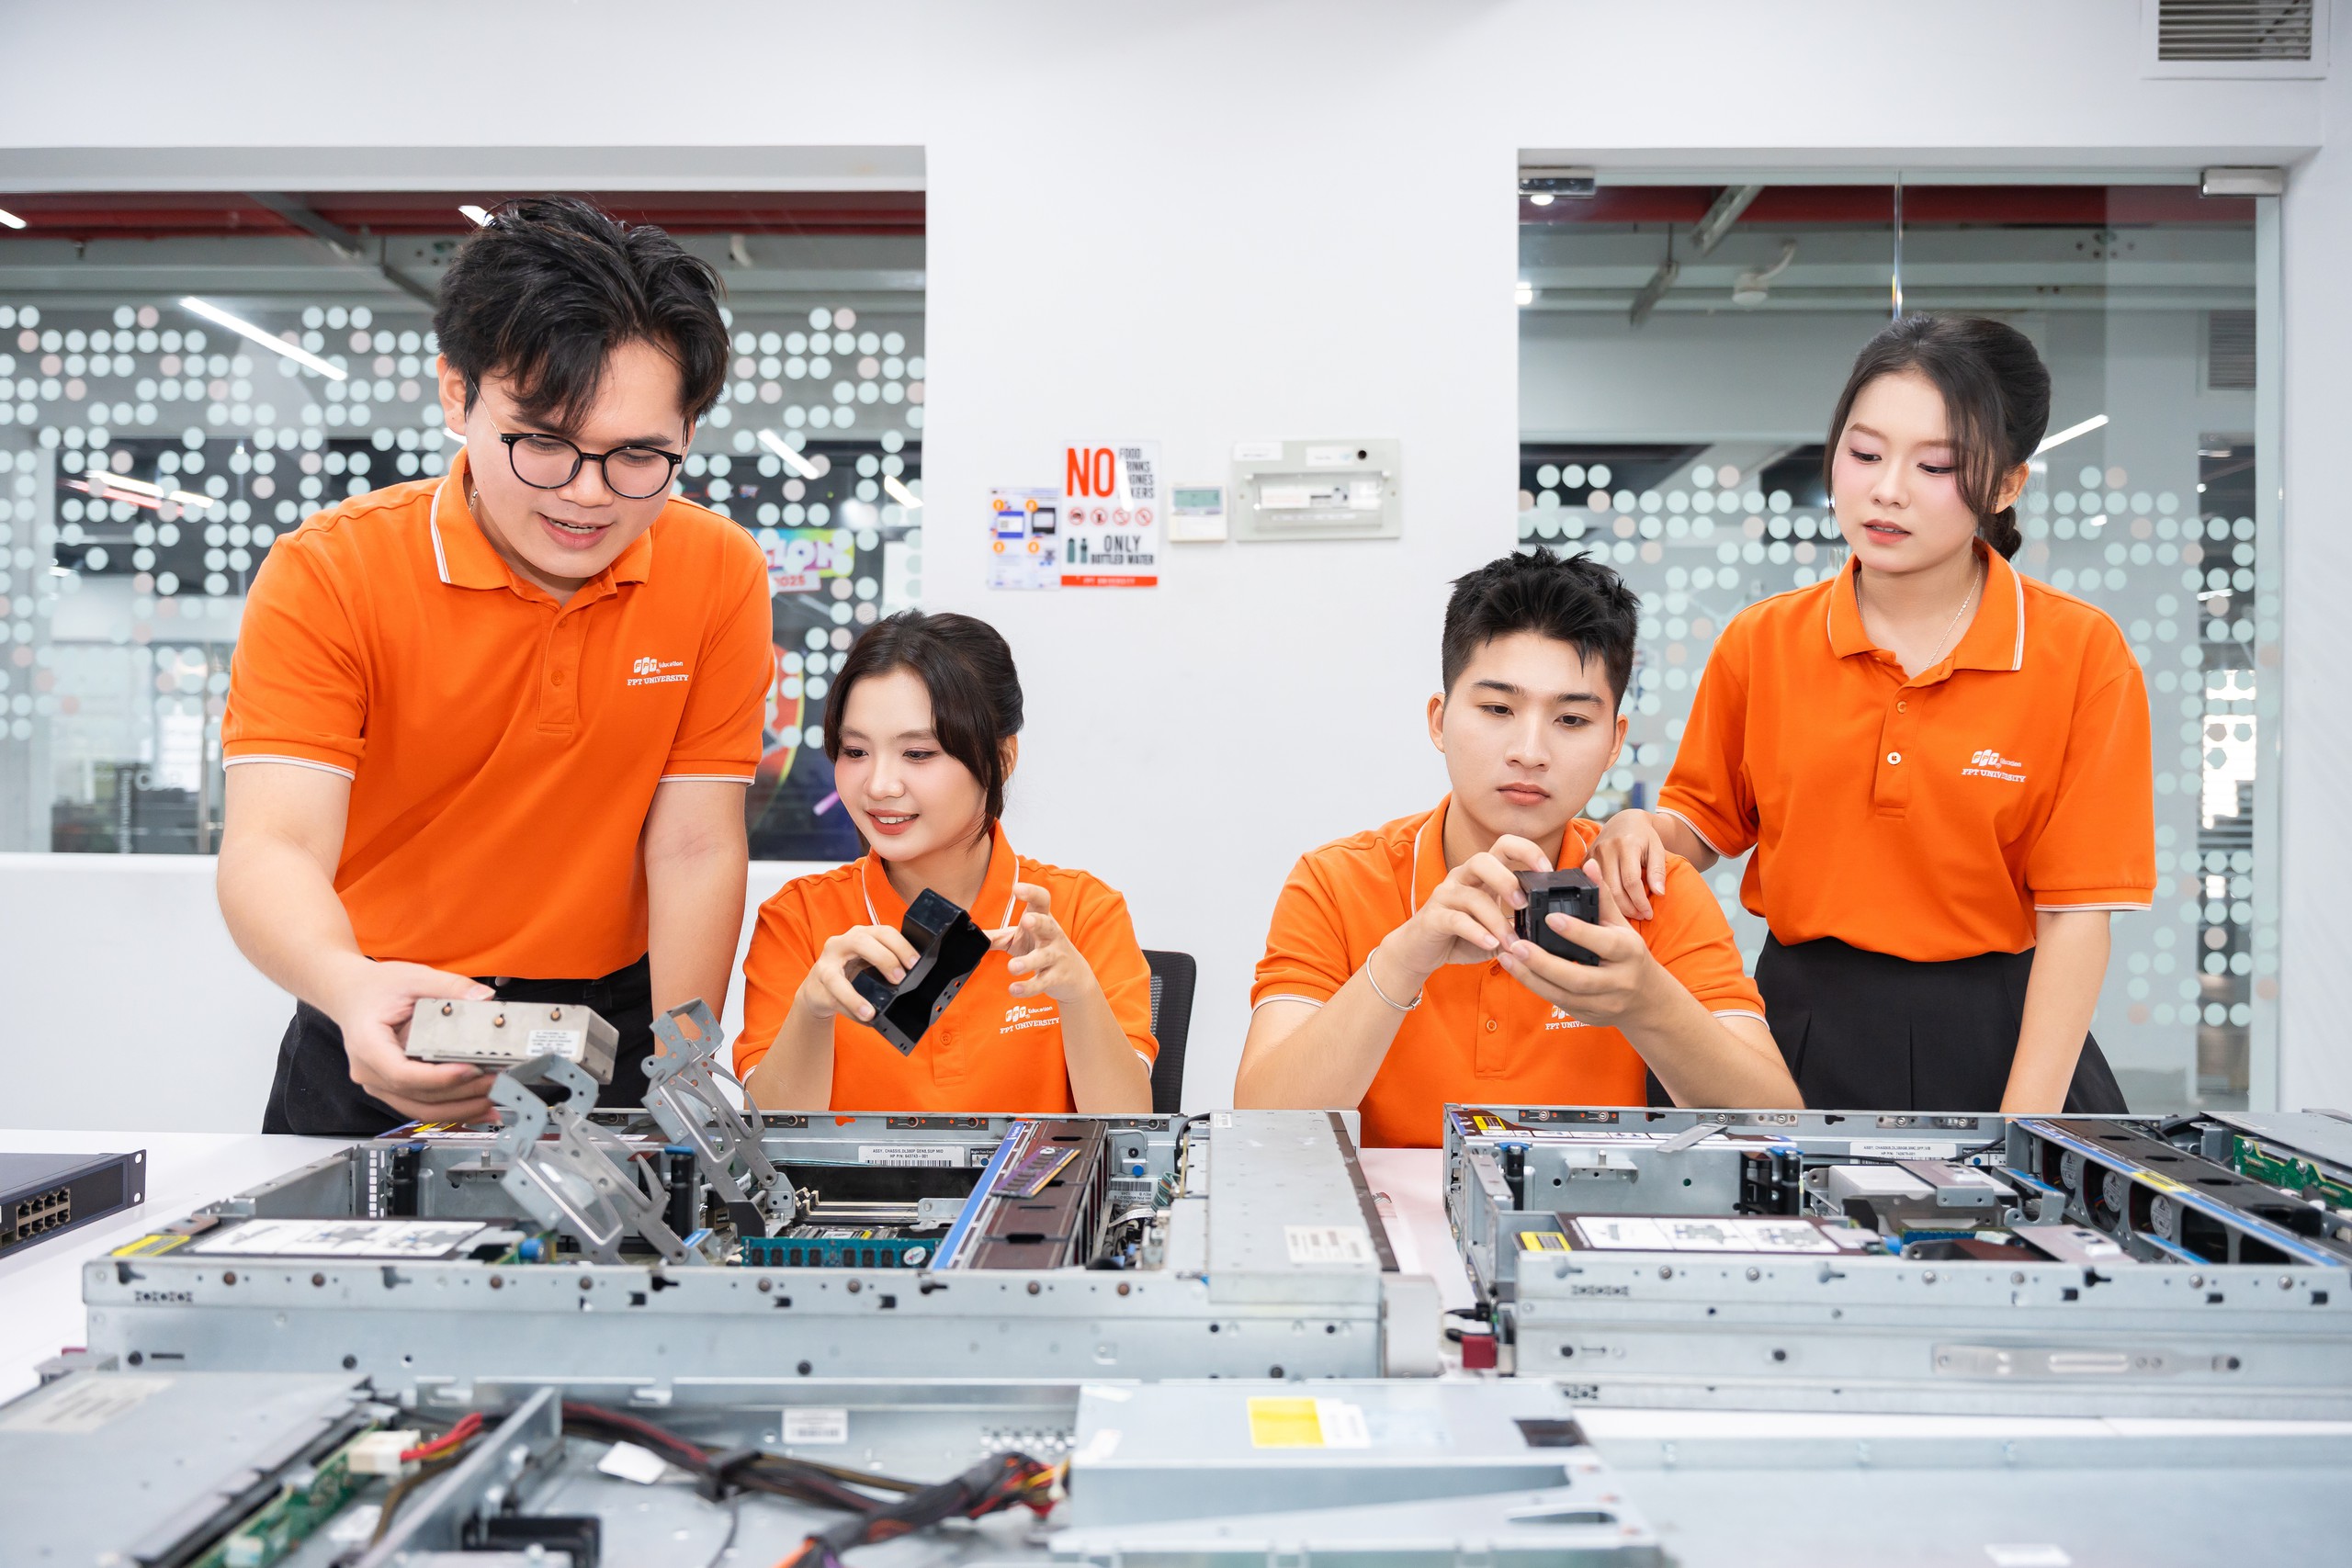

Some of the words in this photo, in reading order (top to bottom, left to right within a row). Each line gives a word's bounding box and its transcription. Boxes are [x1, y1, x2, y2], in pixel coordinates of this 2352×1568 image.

[1119, 448, 1141, 459] FOOD
[1068, 448, 1114, 497] NO
[1125, 461, 1150, 472] RINKS
[1127, 474, 1153, 486] ONES
[1104, 536, 1140, 552] ONLY
[1091, 554, 1123, 564] BOTTLED
[1128, 555, 1153, 565] WATER
[634, 657, 657, 675] FPT
[628, 678, 642, 686] FPT
[644, 674, 689, 684] UNIVERSITY
[1971, 749, 1999, 766] FPT
[1962, 768, 1980, 776] FPT
[1980, 770, 2026, 783] UNIVERSITY
[1005, 1006, 1026, 1022] FPT
[1028, 1006, 1053, 1014] Education
[1000, 1025, 1014, 1034] FPT
[1015, 1017, 1060, 1030] UNIVERSITY
